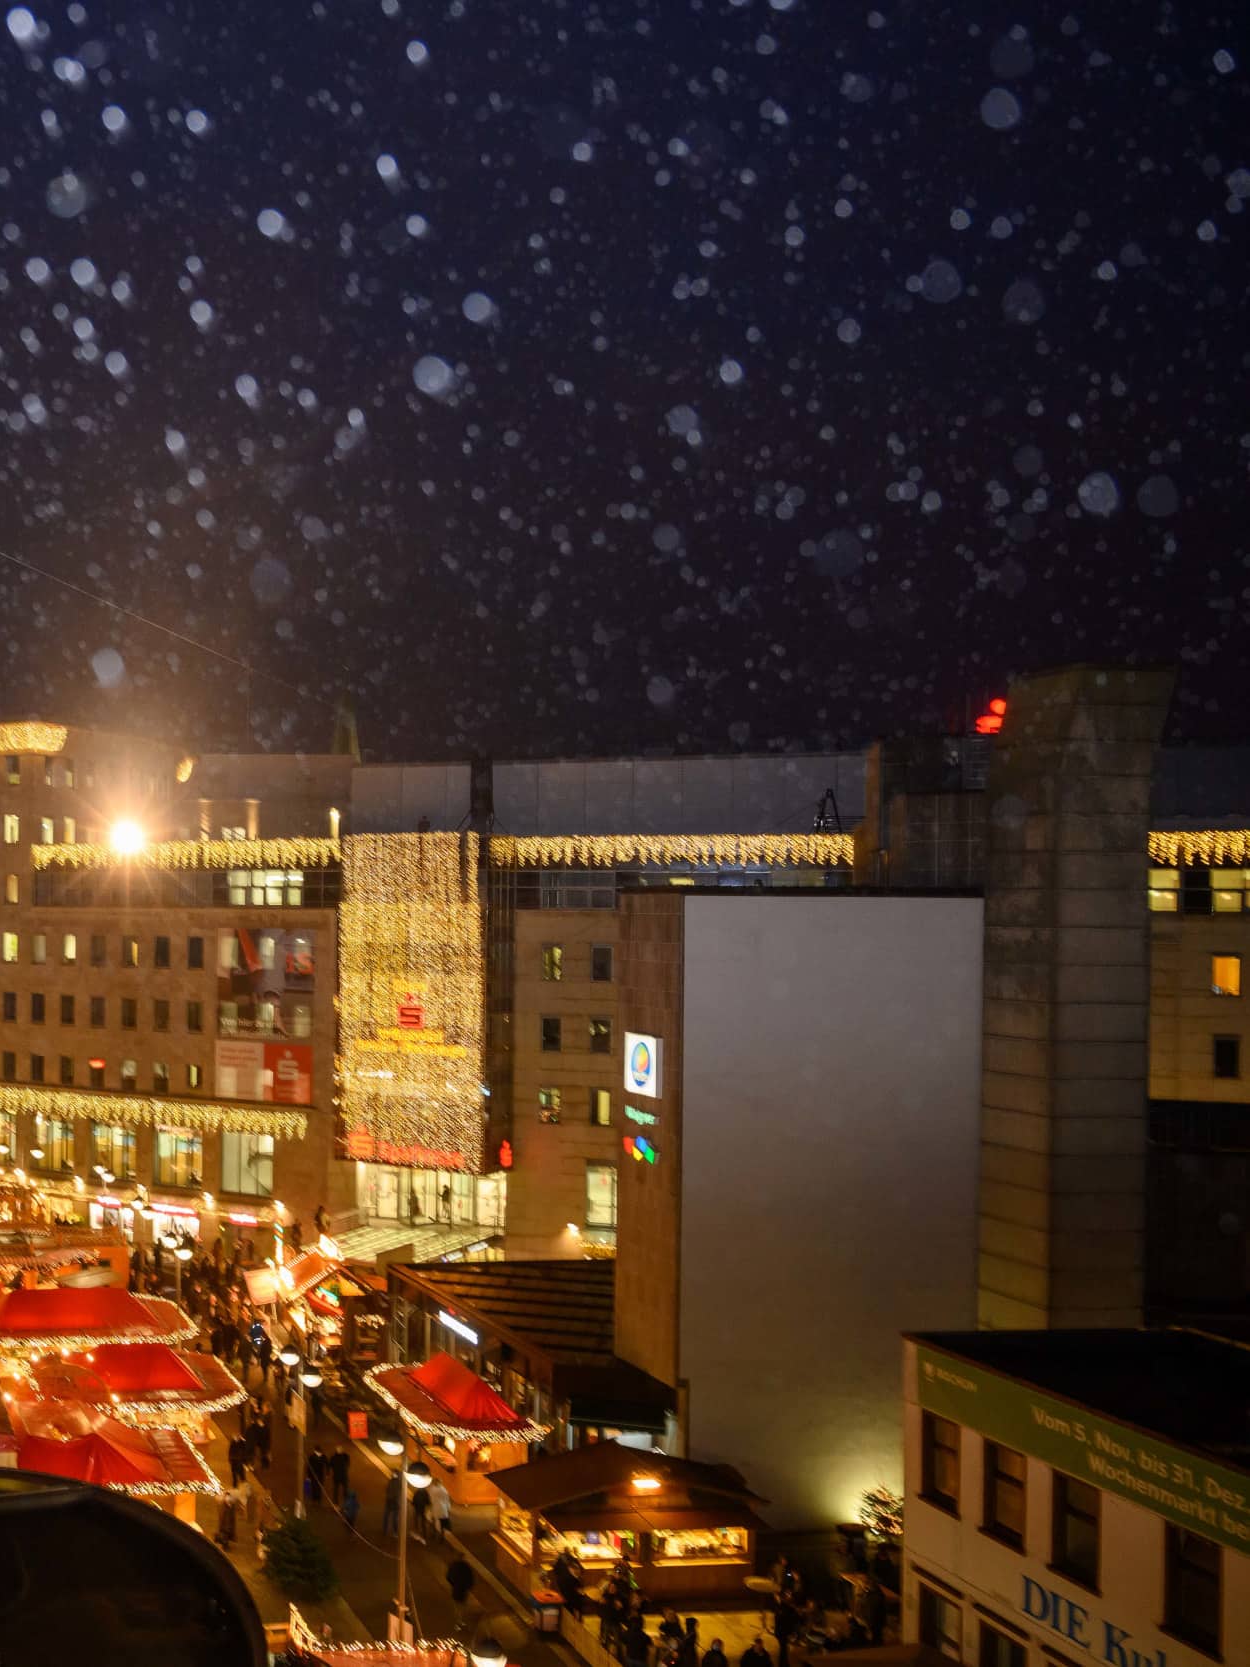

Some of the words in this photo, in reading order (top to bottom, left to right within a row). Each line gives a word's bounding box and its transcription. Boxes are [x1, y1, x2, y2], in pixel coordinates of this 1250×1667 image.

[1030, 1404, 1071, 1437] Vom
[1073, 1422, 1092, 1446] 5.
[1093, 1430, 1136, 1464] Nov.
[1137, 1449, 1168, 1478] bis
[1170, 1462, 1201, 1493] 31.
[1086, 1449, 1217, 1527] Wochenmarkt
[1021, 1574, 1092, 1650] DIE
